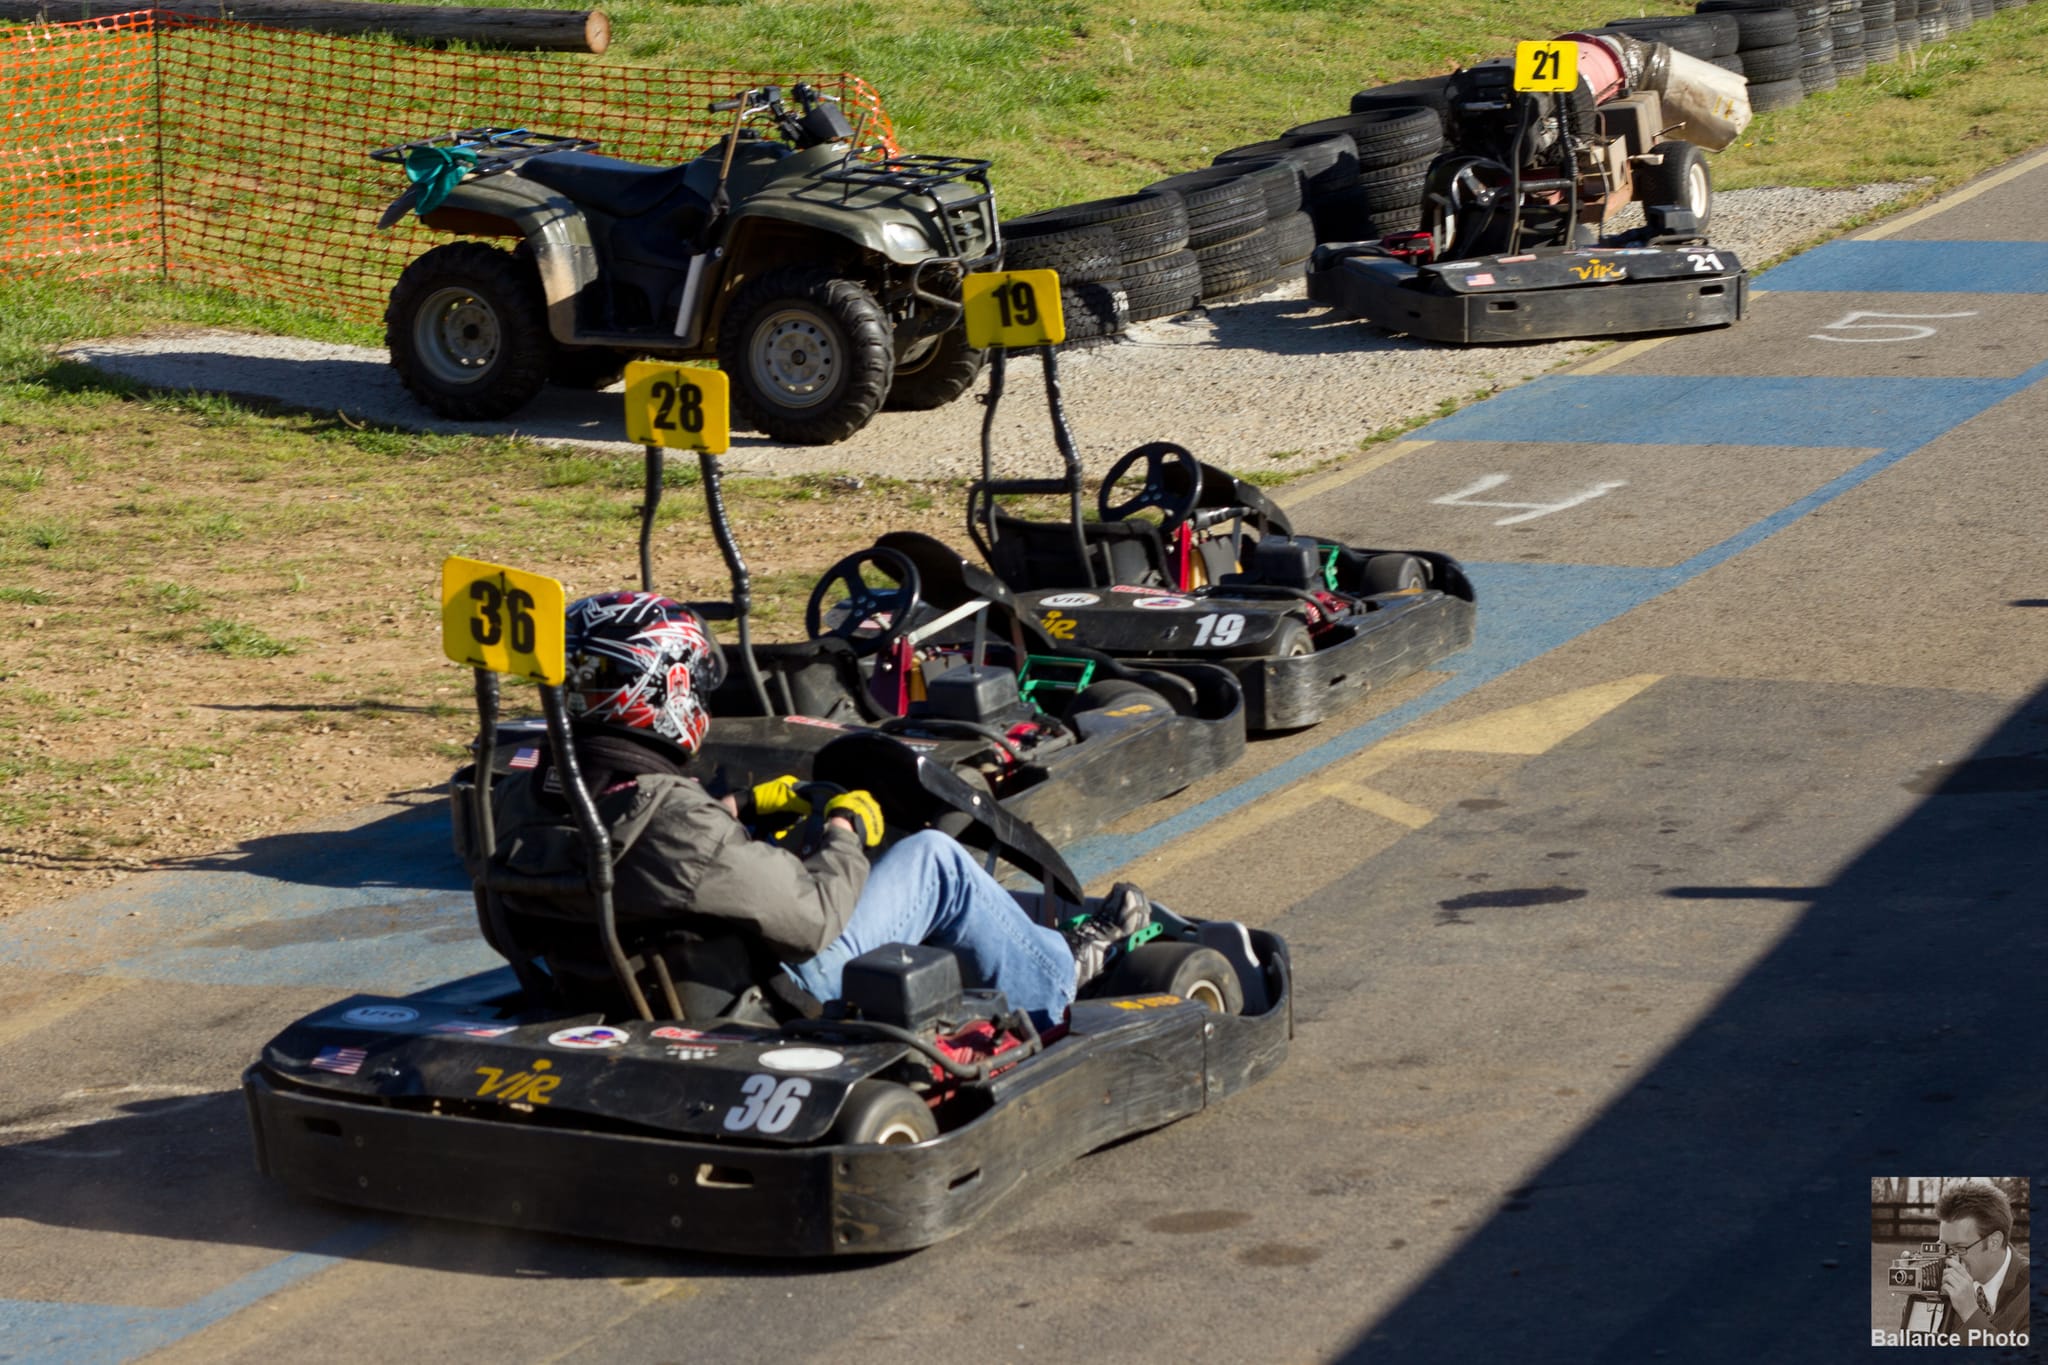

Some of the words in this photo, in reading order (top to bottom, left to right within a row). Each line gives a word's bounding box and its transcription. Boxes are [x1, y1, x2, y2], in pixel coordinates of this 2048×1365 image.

[1532, 50, 1560, 80] 21
[1687, 253, 1724, 271] 21
[991, 282, 1038, 327] 19
[1808, 311, 1979, 343] 5
[651, 381, 704, 433] 28
[470, 580, 535, 654] 36
[1193, 613, 1245, 646] 19
[723, 1074, 812, 1134] 36
